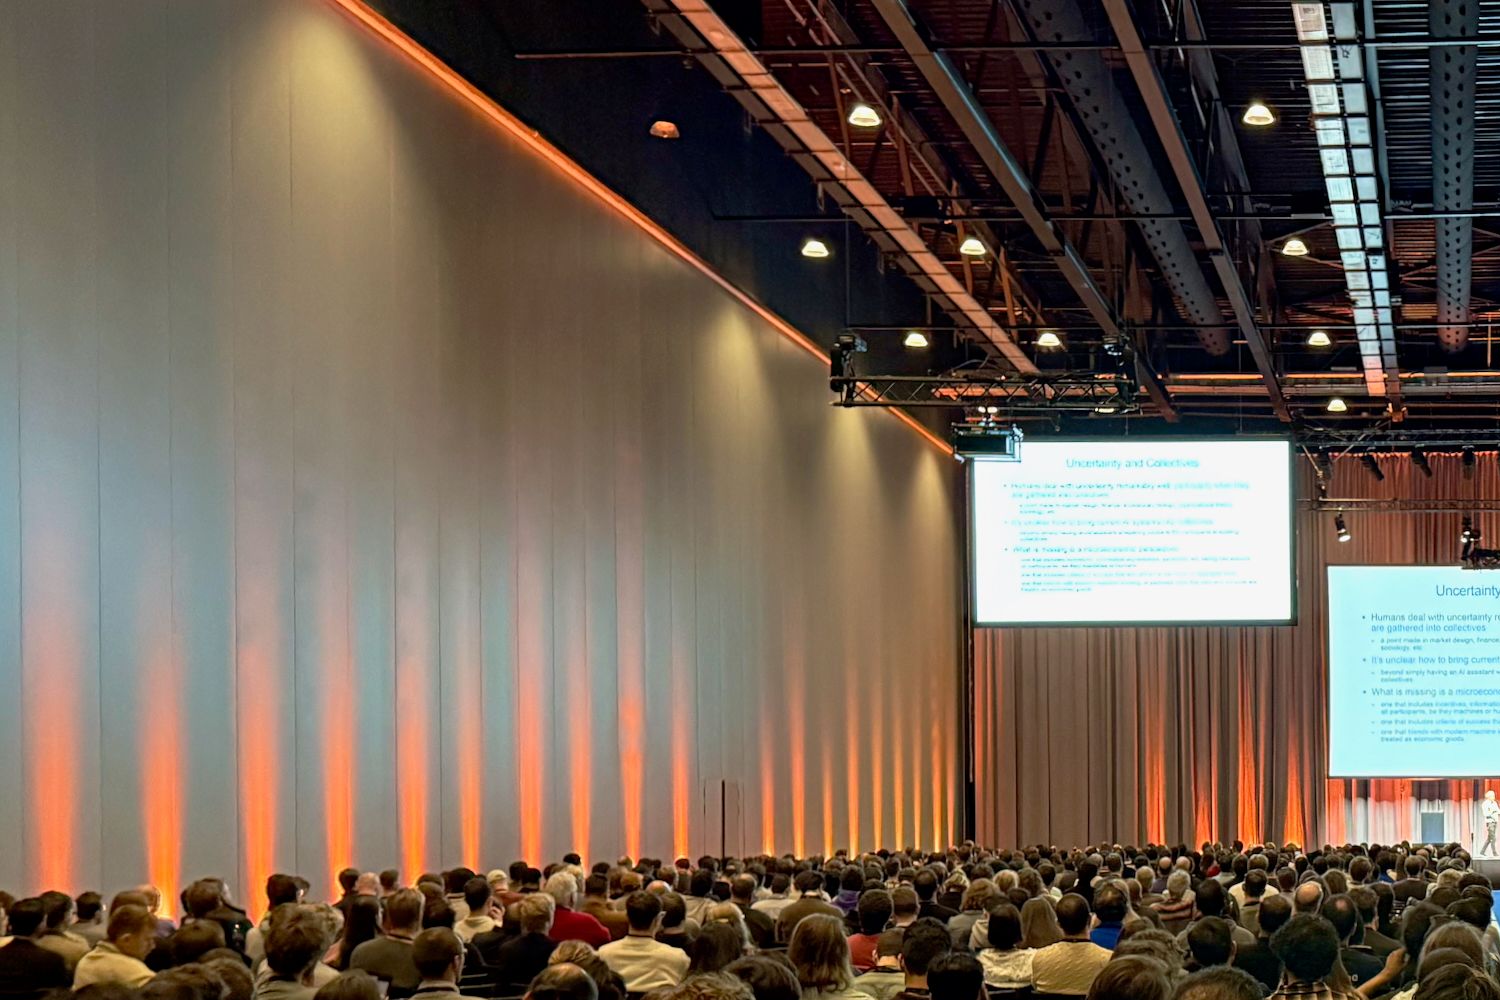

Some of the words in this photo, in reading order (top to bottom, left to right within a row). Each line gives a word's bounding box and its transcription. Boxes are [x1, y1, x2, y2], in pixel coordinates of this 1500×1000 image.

[1066, 458, 1121, 470] Uncertainty
[1125, 459, 1143, 468] and
[1371, 613, 1405, 621] Humans
[1408, 613, 1425, 621] deal
[1428, 613, 1445, 621] with
[1447, 613, 1492, 622] uncertainty
[1387, 624, 1423, 633] gathered
[1426, 624, 1441, 632] into
[1443, 624, 1486, 632] collectives
[1386, 656, 1415, 664] unclear
[1419, 656, 1435, 664] how
[1438, 656, 1445, 664] to
[1448, 656, 1468, 665] bring
[1471, 656, 1499, 664] current
[1405, 688, 1436, 697] missing
